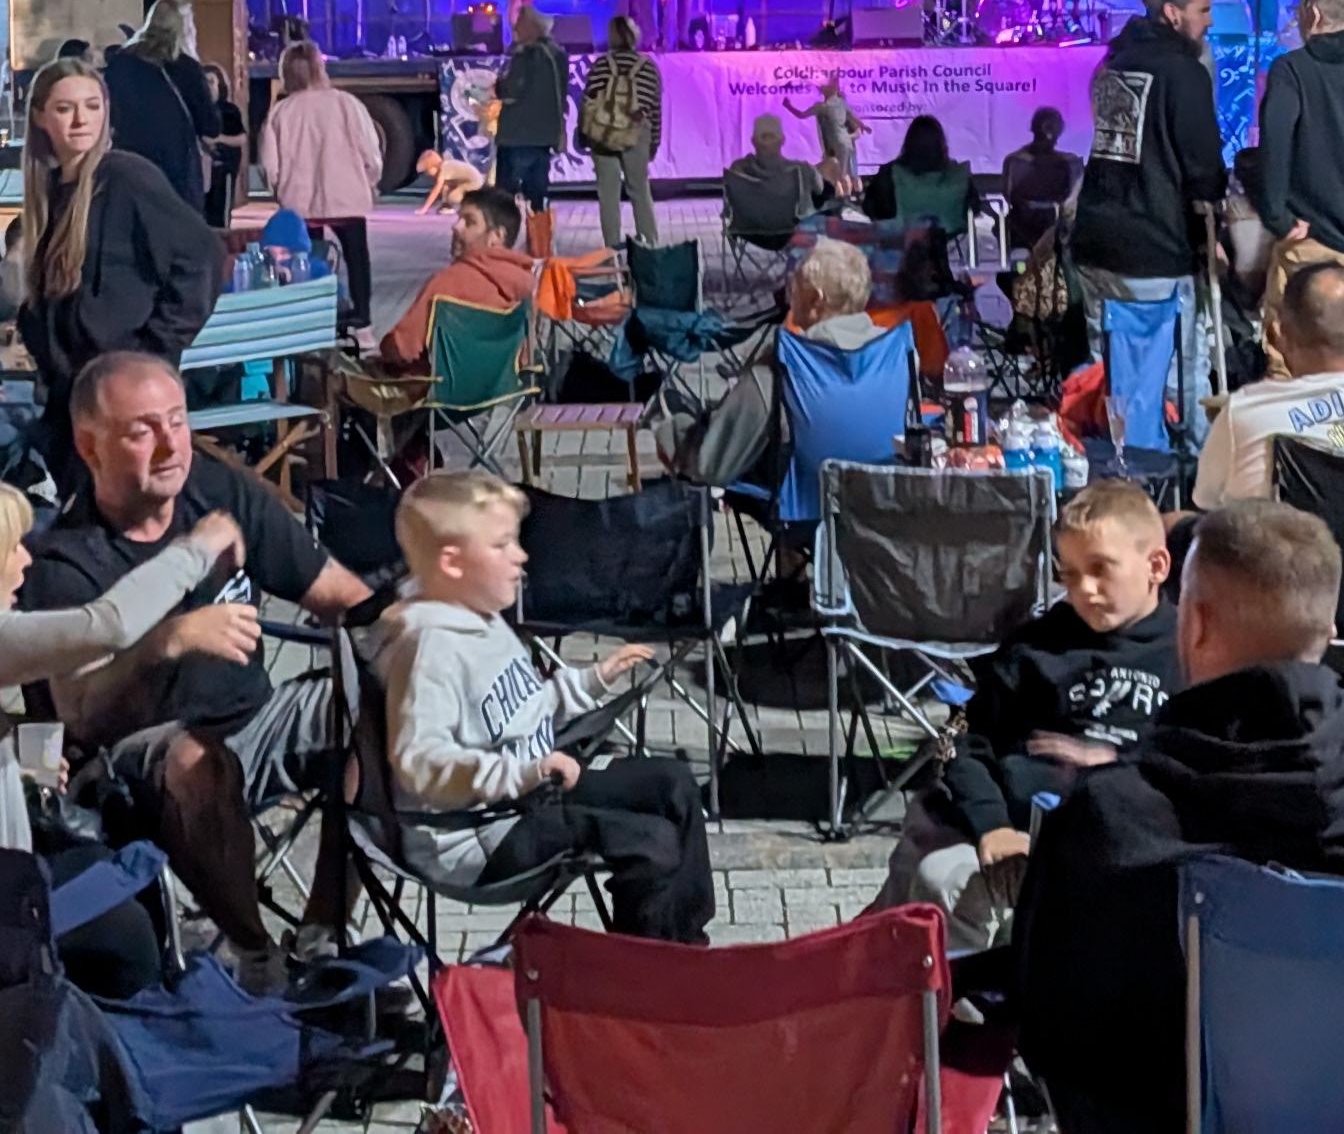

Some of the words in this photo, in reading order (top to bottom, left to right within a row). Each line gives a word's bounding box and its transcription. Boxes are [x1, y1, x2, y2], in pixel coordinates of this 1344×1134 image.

[878, 64, 929, 79] Parish
[931, 63, 992, 78] Council
[728, 81, 812, 96] Welcomes
[849, 82, 867, 94] to
[871, 80, 920, 94] Music
[943, 79, 971, 93] the
[974, 77, 1038, 95] Square!
[481, 656, 542, 744] CHICA
